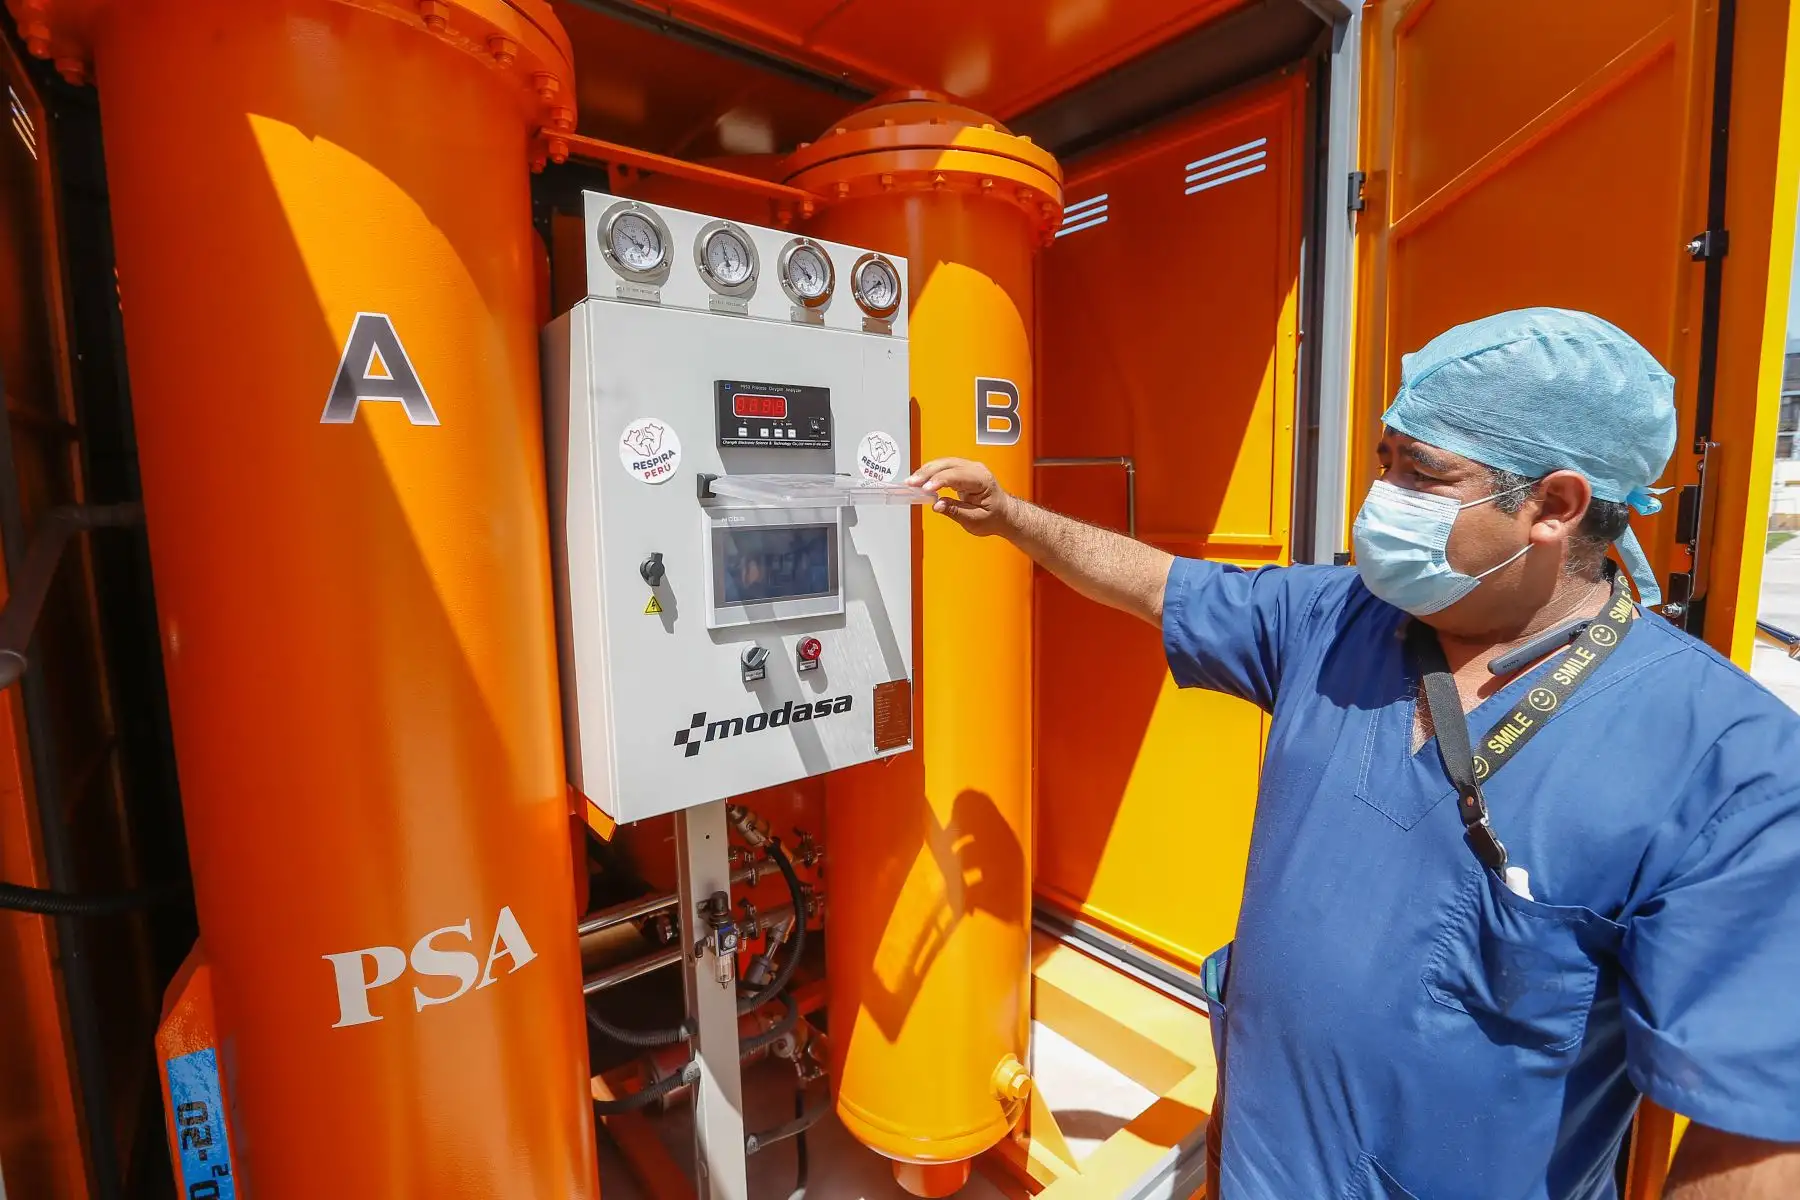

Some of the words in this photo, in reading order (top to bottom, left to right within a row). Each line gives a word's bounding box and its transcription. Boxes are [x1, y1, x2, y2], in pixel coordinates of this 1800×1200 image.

[319, 311, 441, 426] A
[975, 376, 1022, 445] B
[633, 449, 676, 470] RESPIRA
[644, 462, 671, 480] PERÚ
[861, 455, 892, 475] RESPIRA
[863, 468, 884, 482] PERÚ
[1608, 590, 1633, 624] SMILE
[1502, 659, 1520, 669] SONY
[1552, 646, 1597, 686] SMILE
[704, 694, 853, 743] modasa
[1487, 711, 1534, 754] SMILE
[321, 905, 538, 1029] PSA
